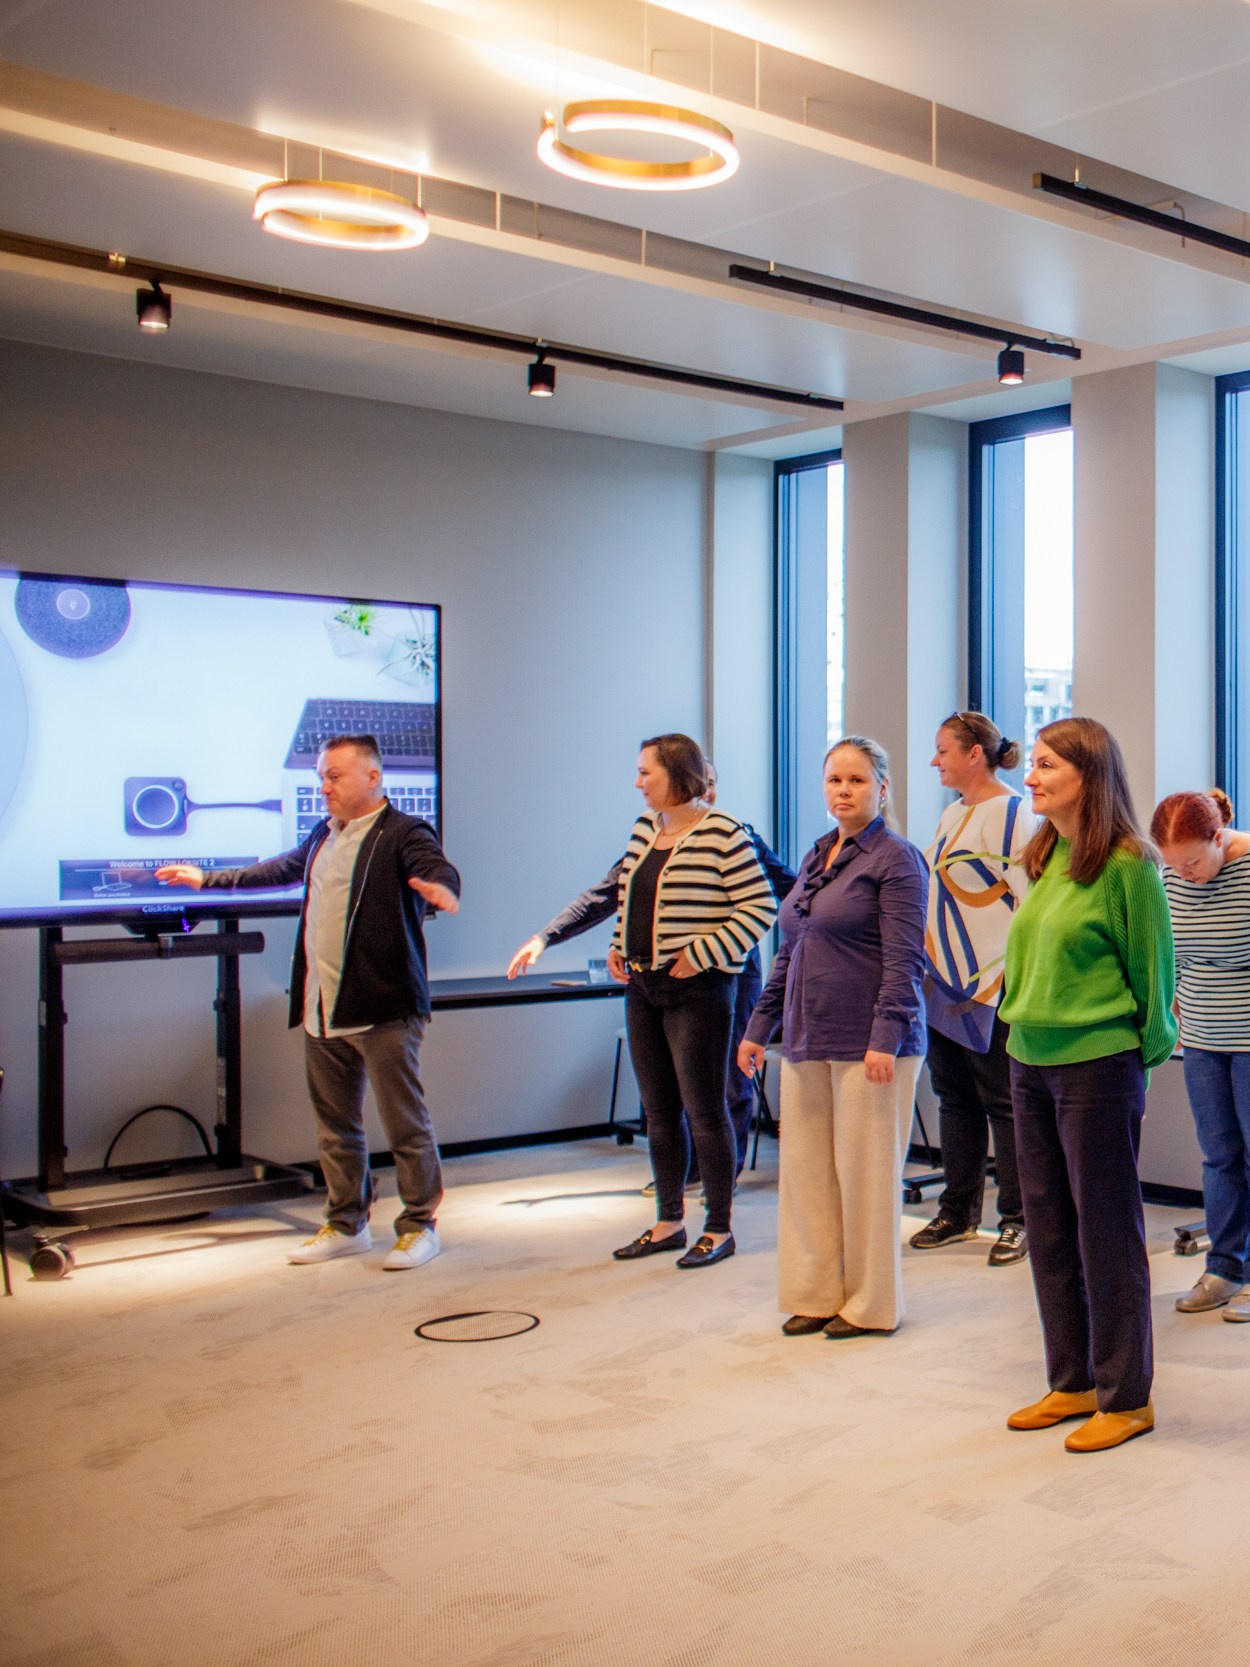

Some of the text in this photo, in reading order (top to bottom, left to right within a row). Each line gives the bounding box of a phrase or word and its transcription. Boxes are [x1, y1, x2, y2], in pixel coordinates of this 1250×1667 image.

[110, 860, 144, 868] Welcome
[146, 860, 153, 868] to
[142, 904, 185, 913] ClickShare
